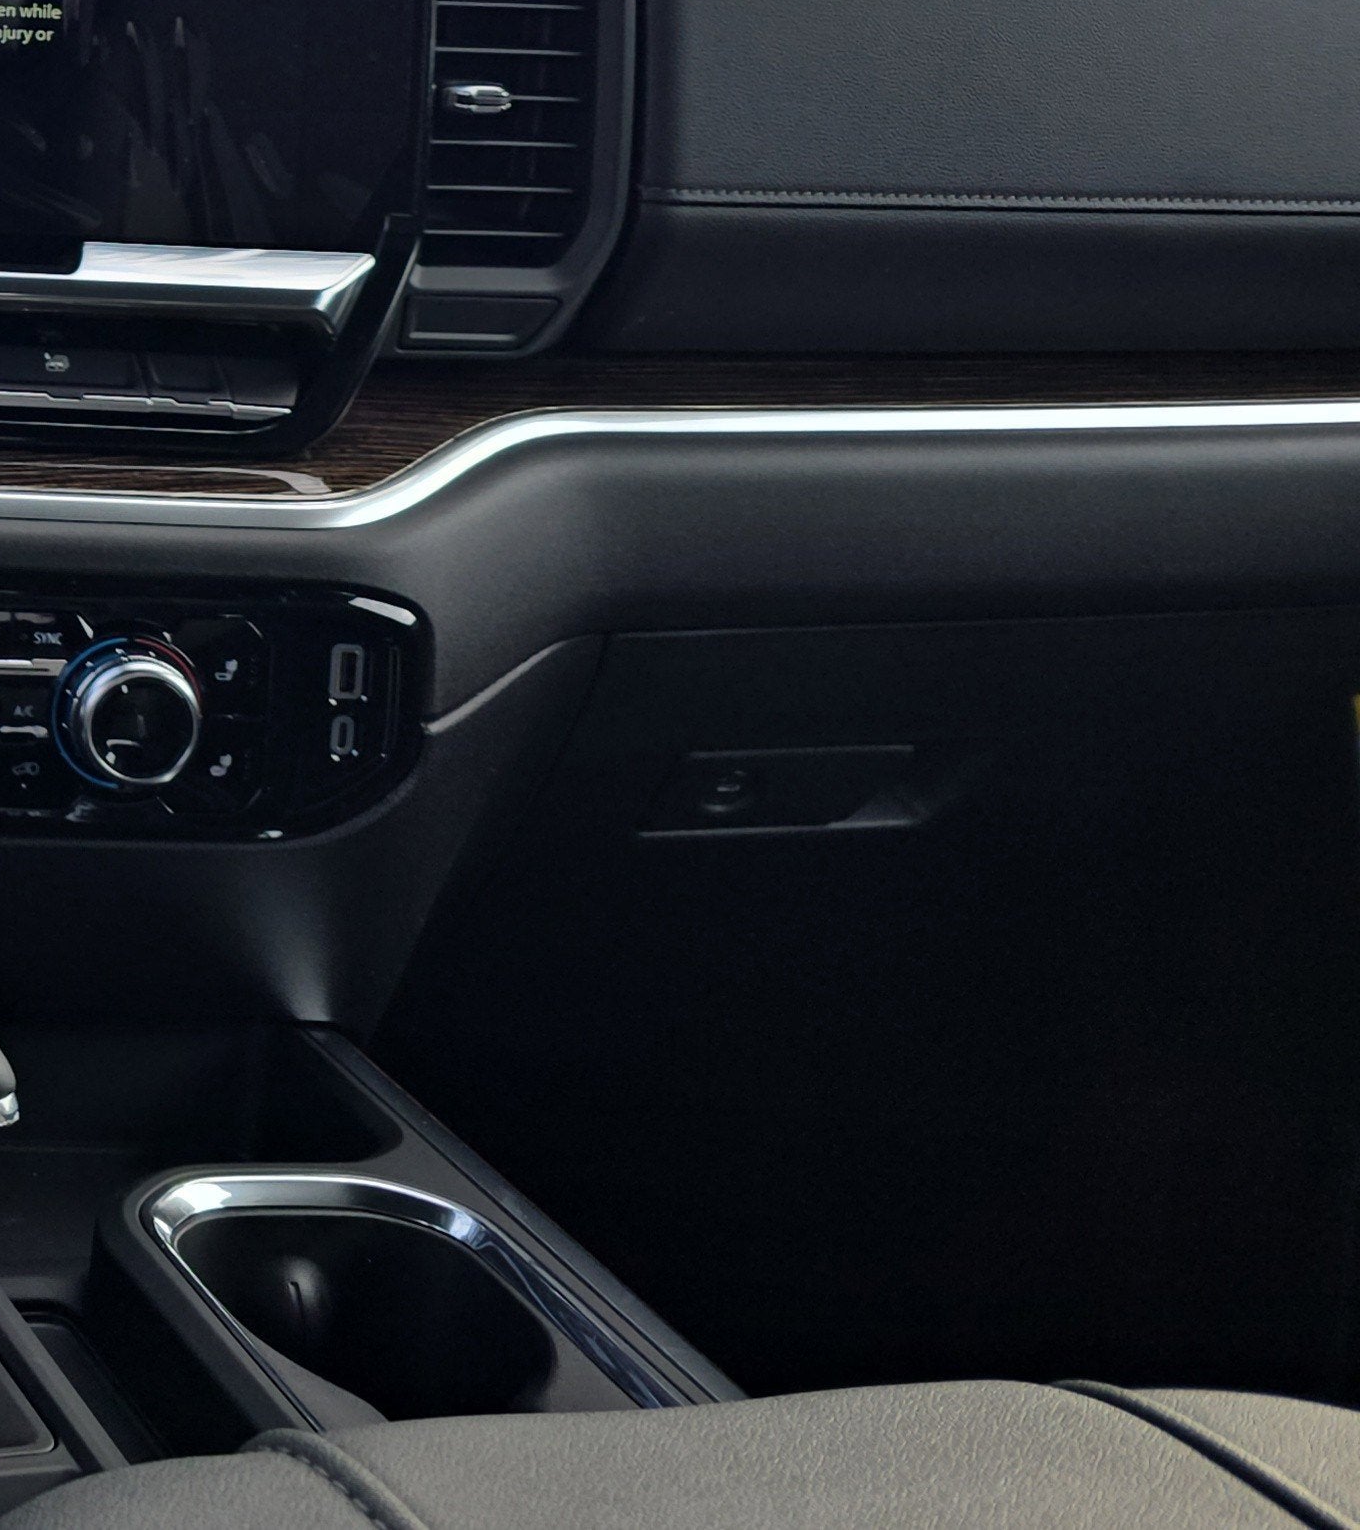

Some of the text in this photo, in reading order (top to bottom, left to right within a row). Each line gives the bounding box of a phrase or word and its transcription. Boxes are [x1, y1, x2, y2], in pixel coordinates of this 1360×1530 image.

[19, 3, 63, 19] while
[35, 30, 54, 42] or
[33, 631, 63, 645] SYNC
[13, 705, 34, 718] A/C
